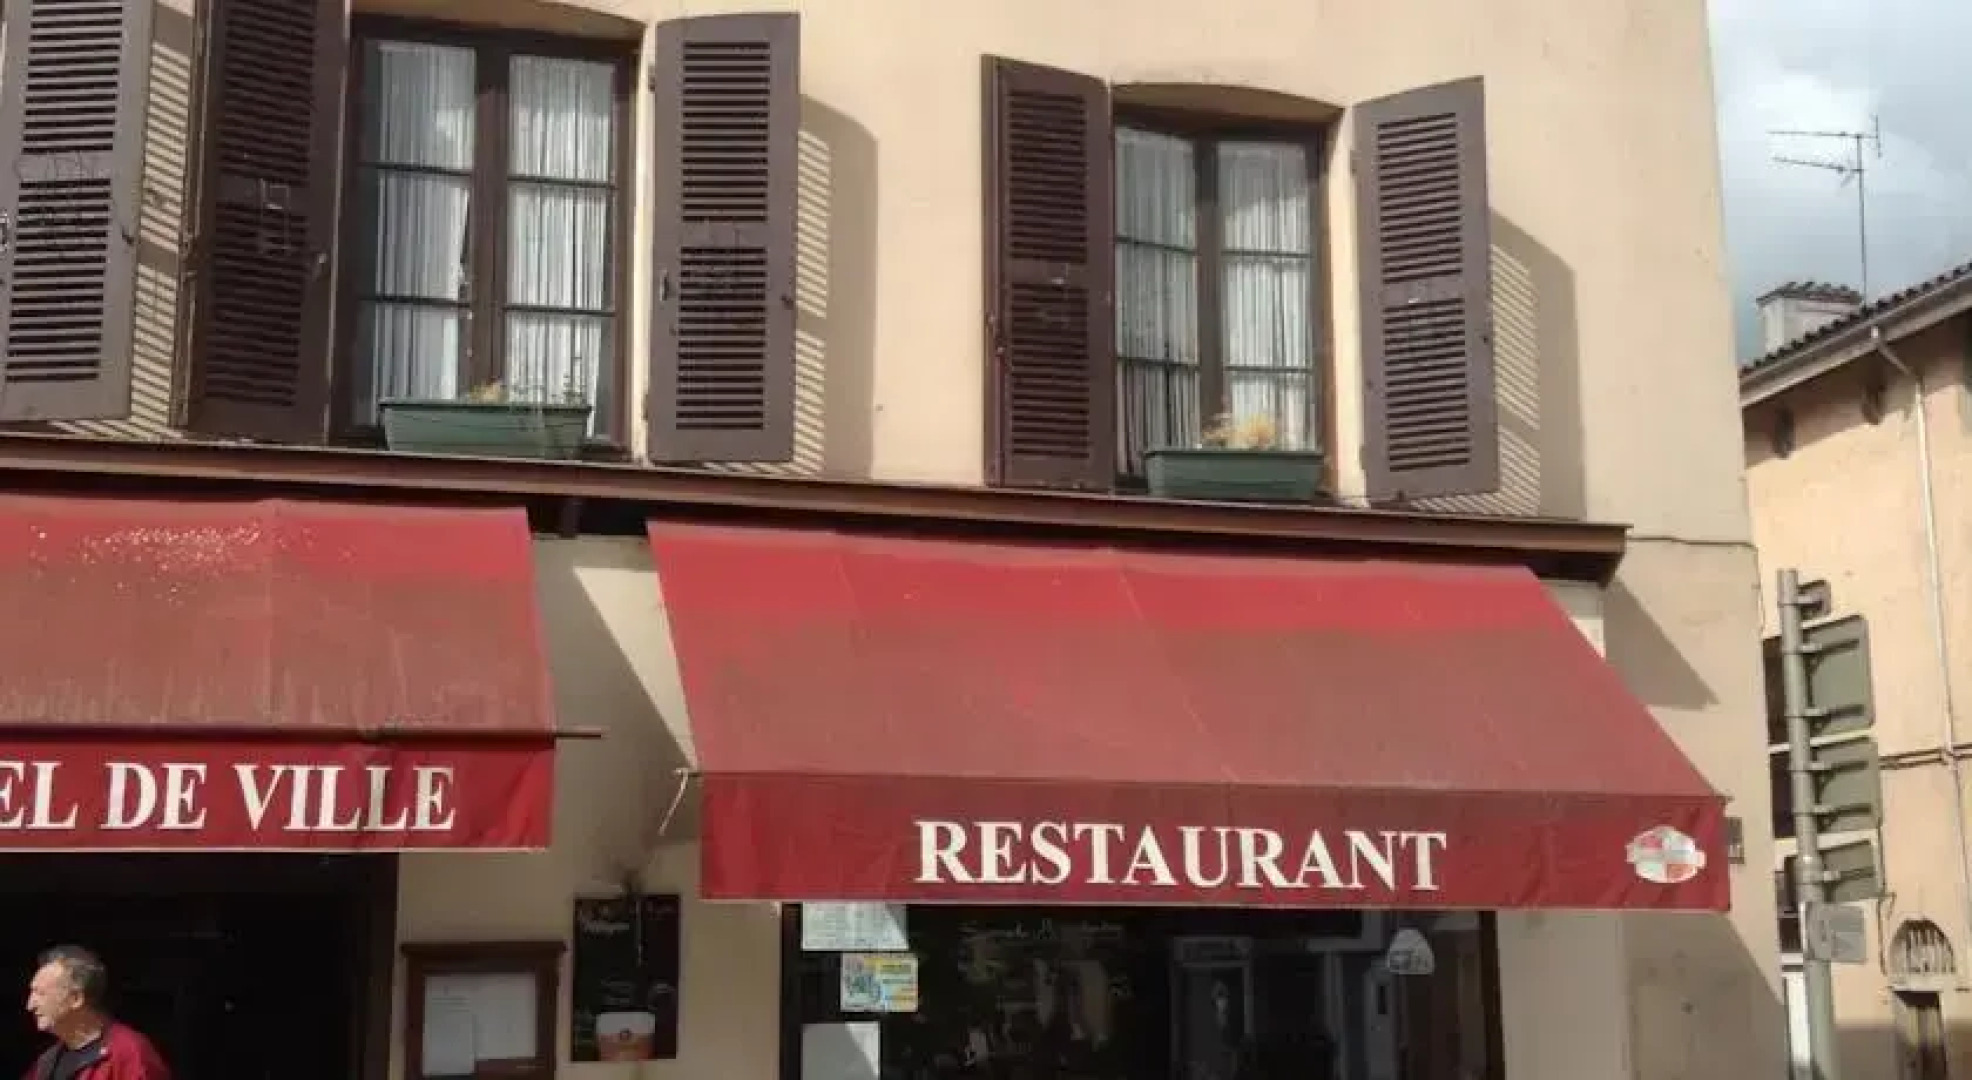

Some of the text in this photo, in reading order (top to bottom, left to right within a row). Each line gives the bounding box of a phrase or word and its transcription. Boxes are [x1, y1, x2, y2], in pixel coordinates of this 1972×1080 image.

[99, 762, 208, 830] DE
[232, 763, 456, 832] VILLE
[915, 820, 1447, 891] RESTAURANT
